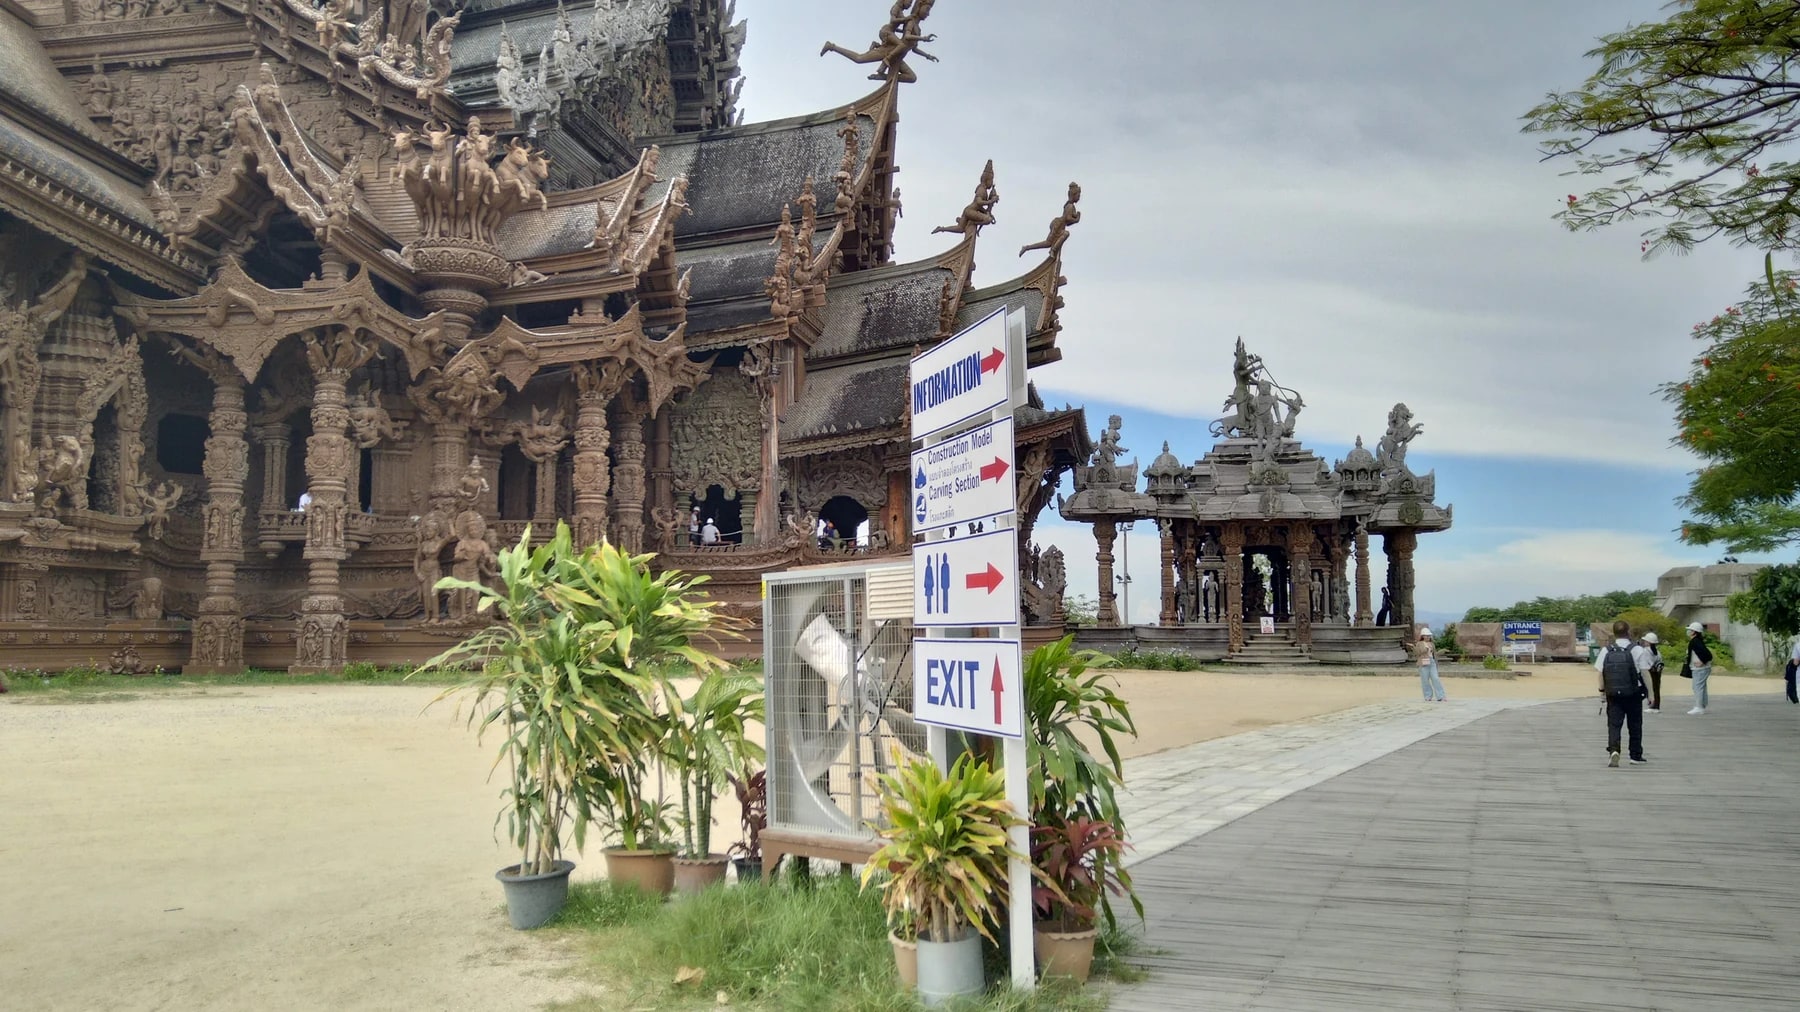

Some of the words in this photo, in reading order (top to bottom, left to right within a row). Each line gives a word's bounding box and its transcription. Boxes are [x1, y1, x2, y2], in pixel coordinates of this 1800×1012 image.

[914, 351, 981, 415] INFORMATION
[928, 440, 969, 465] Construction
[971, 427, 993, 450] Model
[928, 482, 953, 501] Carving
[955, 473, 980, 493] Section
[927, 659, 979, 709] EXIT
